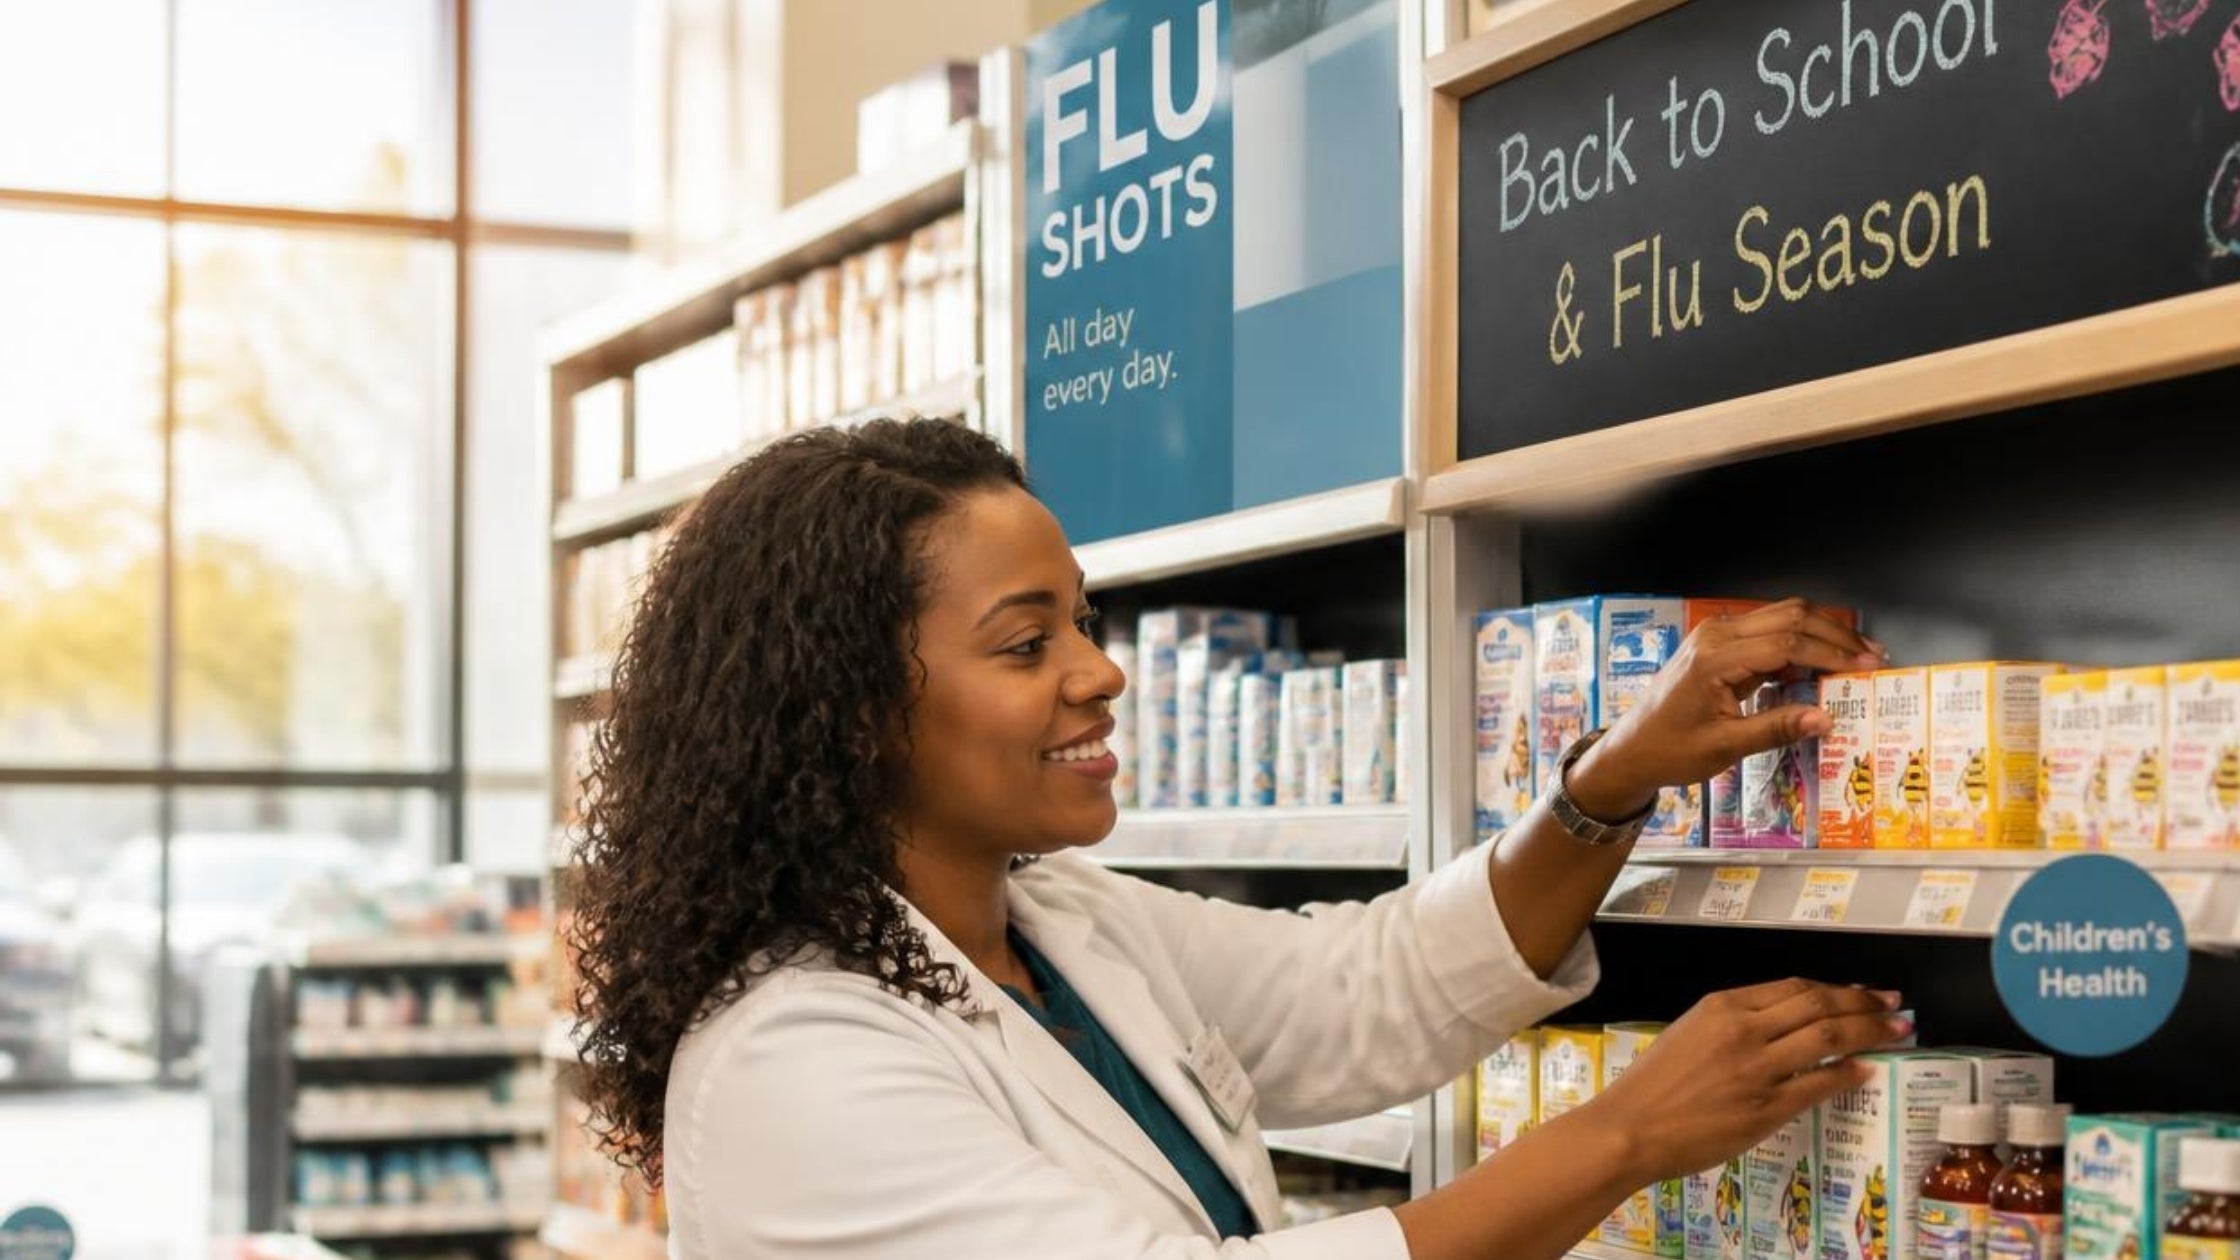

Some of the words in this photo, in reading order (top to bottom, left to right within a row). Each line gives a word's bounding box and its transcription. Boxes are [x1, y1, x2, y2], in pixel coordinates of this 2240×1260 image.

[1043, 1, 1217, 193] FLU
[1499, 95, 1637, 233] Back
[1661, 76, 1726, 170] to
[1041, 153, 1218, 279] SHOTS
[1549, 261, 1585, 365] &
[1612, 234, 1705, 350] Flu
[1733, 174, 1992, 315] Season
[1043, 317, 1076, 359] All
[1084, 308, 1135, 349] day
[1043, 367, 1114, 411] every
[1122, 349, 1179, 391] day.
[2009, 921, 2174, 953] Children's
[2038, 966, 2147, 998] Health
